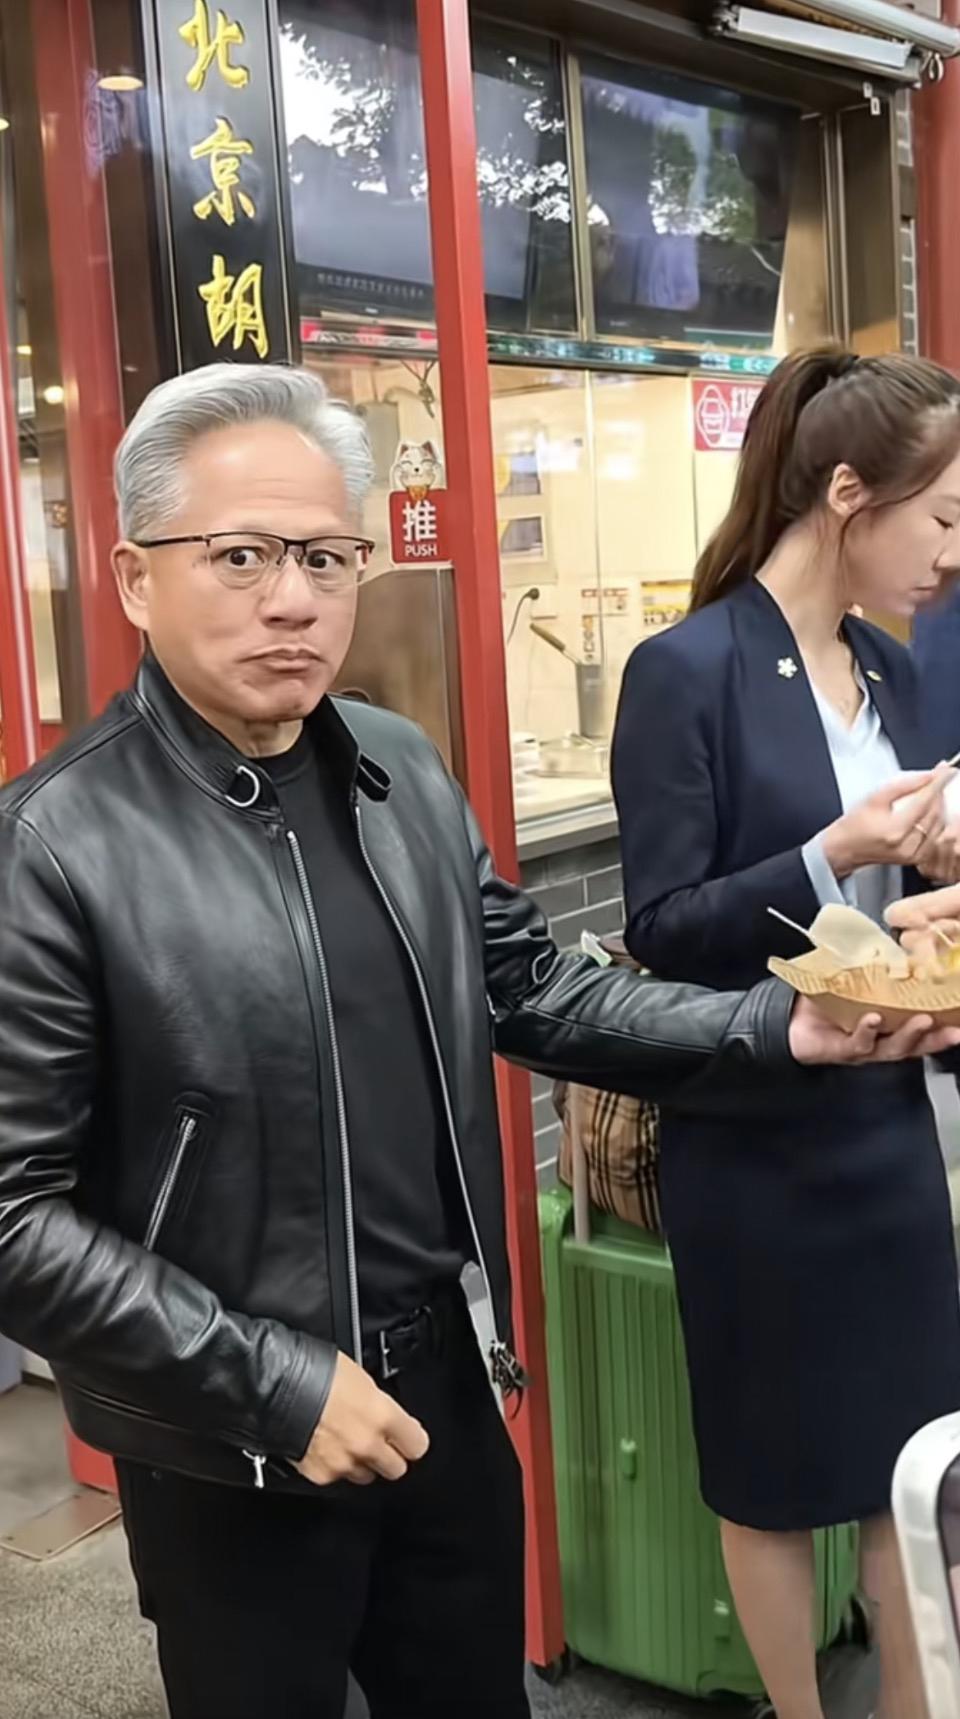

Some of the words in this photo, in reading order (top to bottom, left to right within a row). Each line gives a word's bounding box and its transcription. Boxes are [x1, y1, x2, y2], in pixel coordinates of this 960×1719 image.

[178, 0, 268, 359] 北京胡
[402, 500, 437, 542] 推
[405, 544, 437, 556] PUSH
